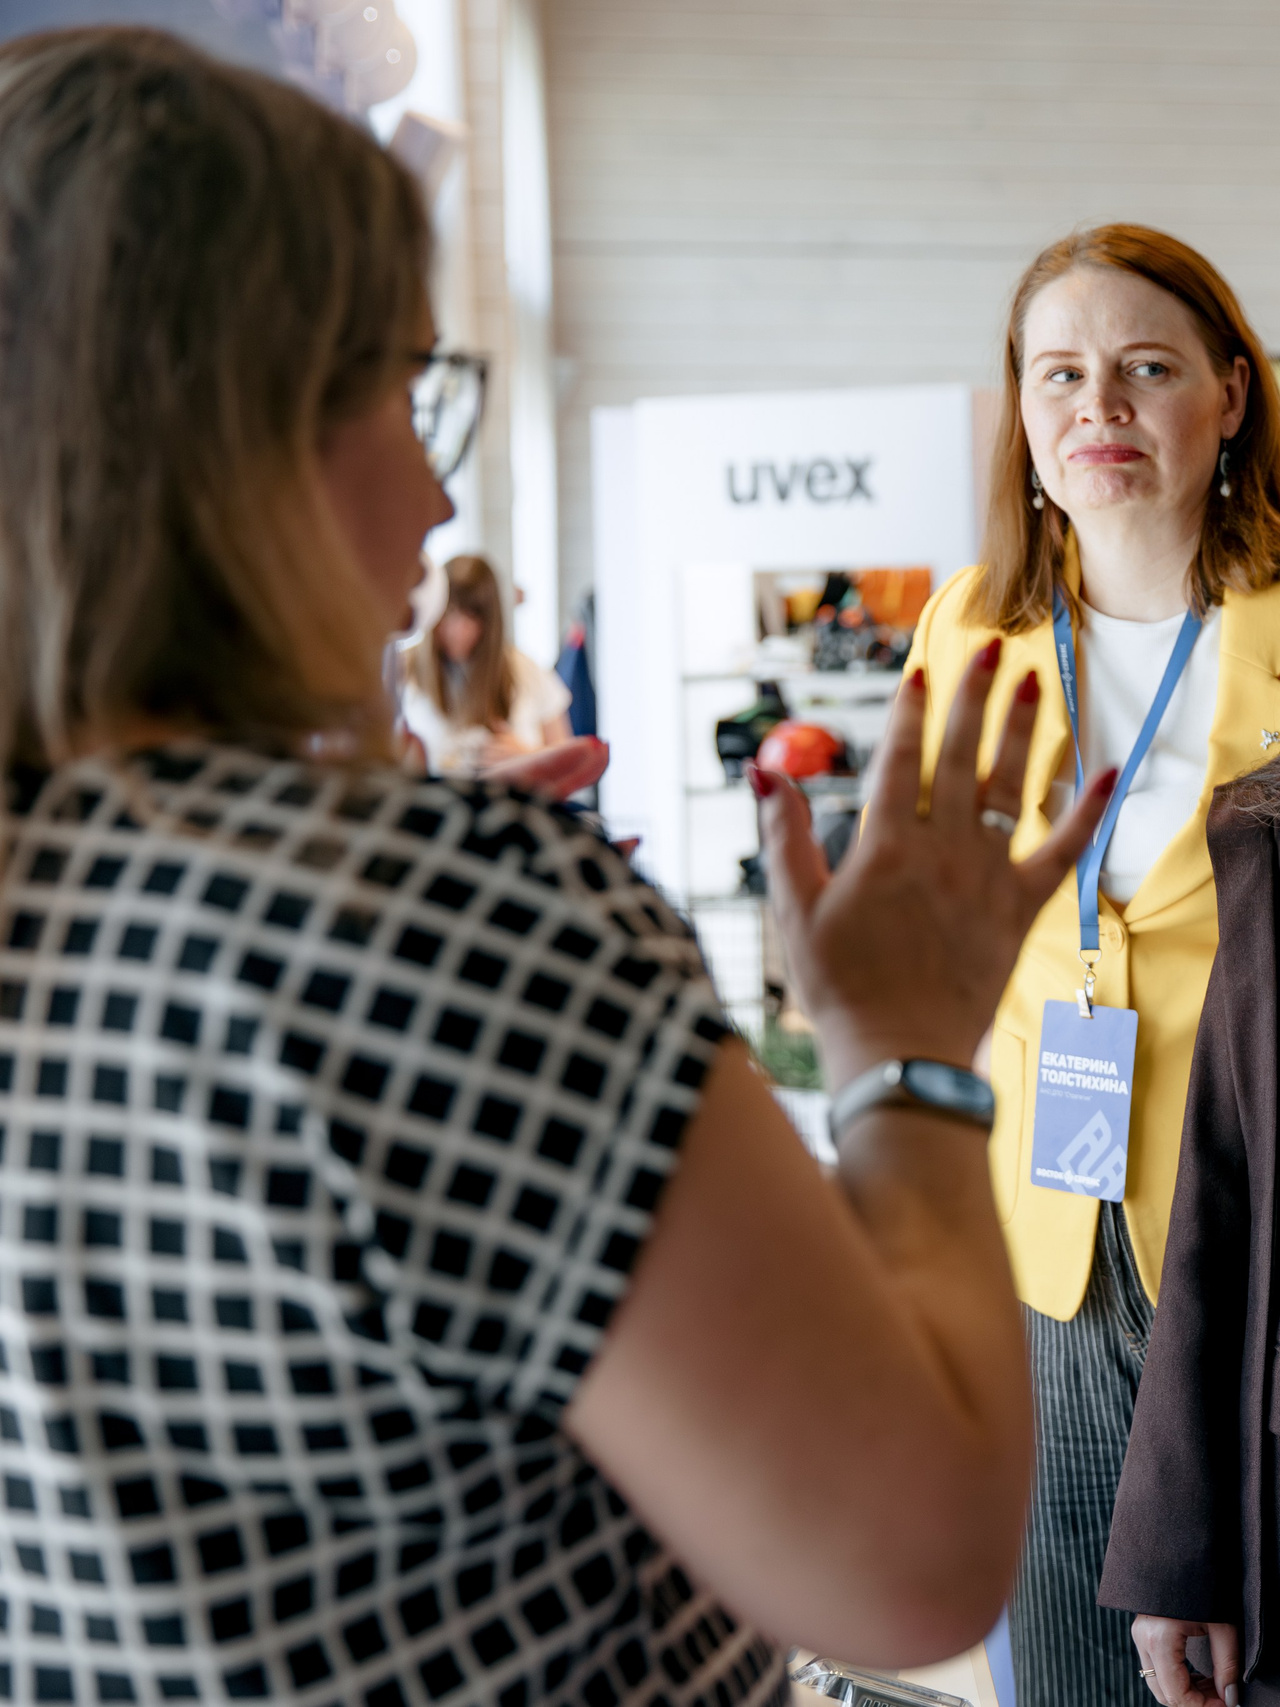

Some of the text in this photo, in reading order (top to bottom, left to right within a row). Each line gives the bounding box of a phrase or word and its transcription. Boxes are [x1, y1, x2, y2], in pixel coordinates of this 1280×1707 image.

[727, 457, 875, 506] uvex
[1041, 1051, 1118, 1076] ЕКАТЕРИНА
[1040, 1068, 1128, 1095] ТОЛСТИХИНА
